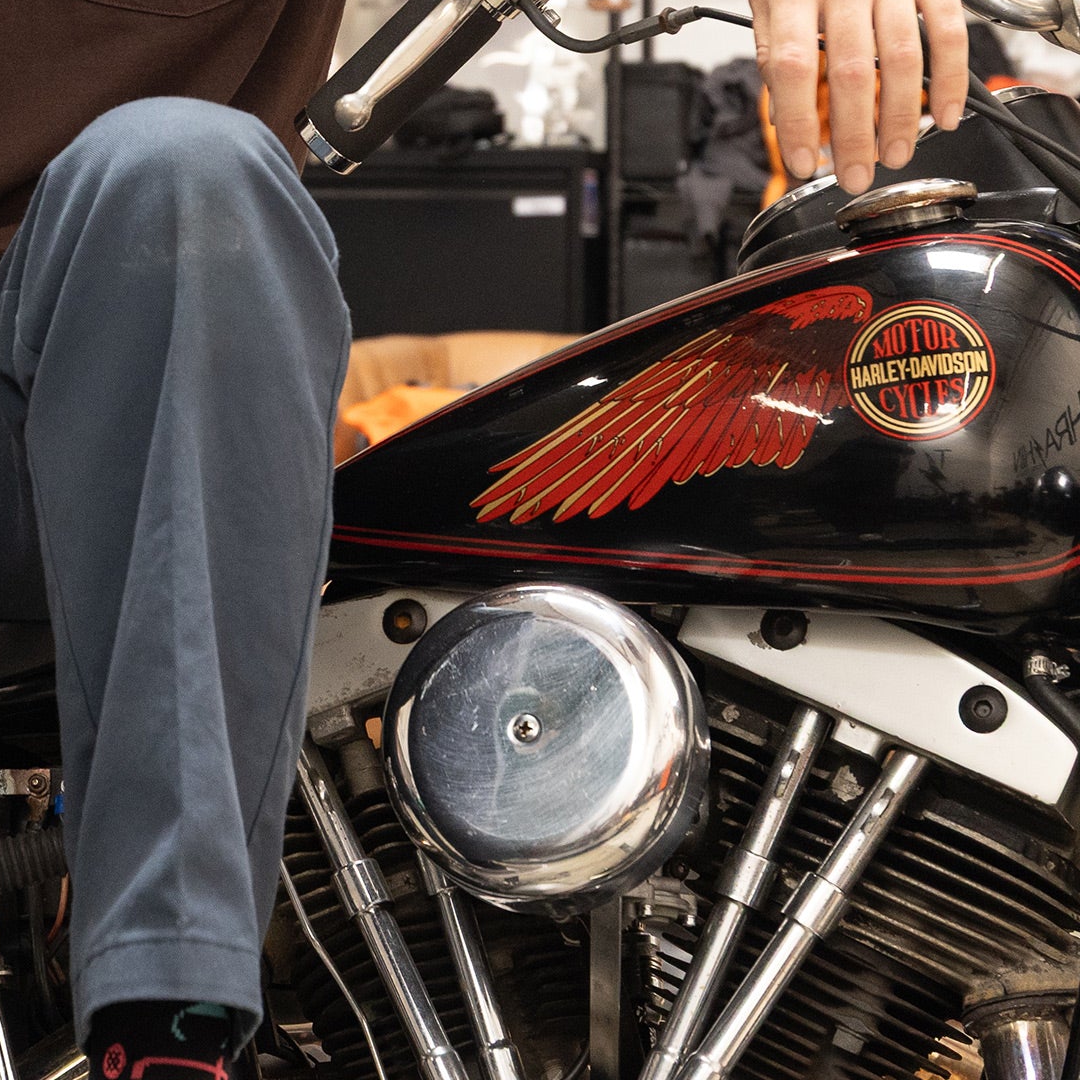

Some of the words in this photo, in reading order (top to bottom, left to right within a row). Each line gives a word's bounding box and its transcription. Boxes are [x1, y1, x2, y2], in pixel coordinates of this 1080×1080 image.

[872, 318, 961, 360] MOTOR
[849, 350, 989, 390] HARLEY-DAVIDSON
[878, 377, 965, 421] CYCLES
